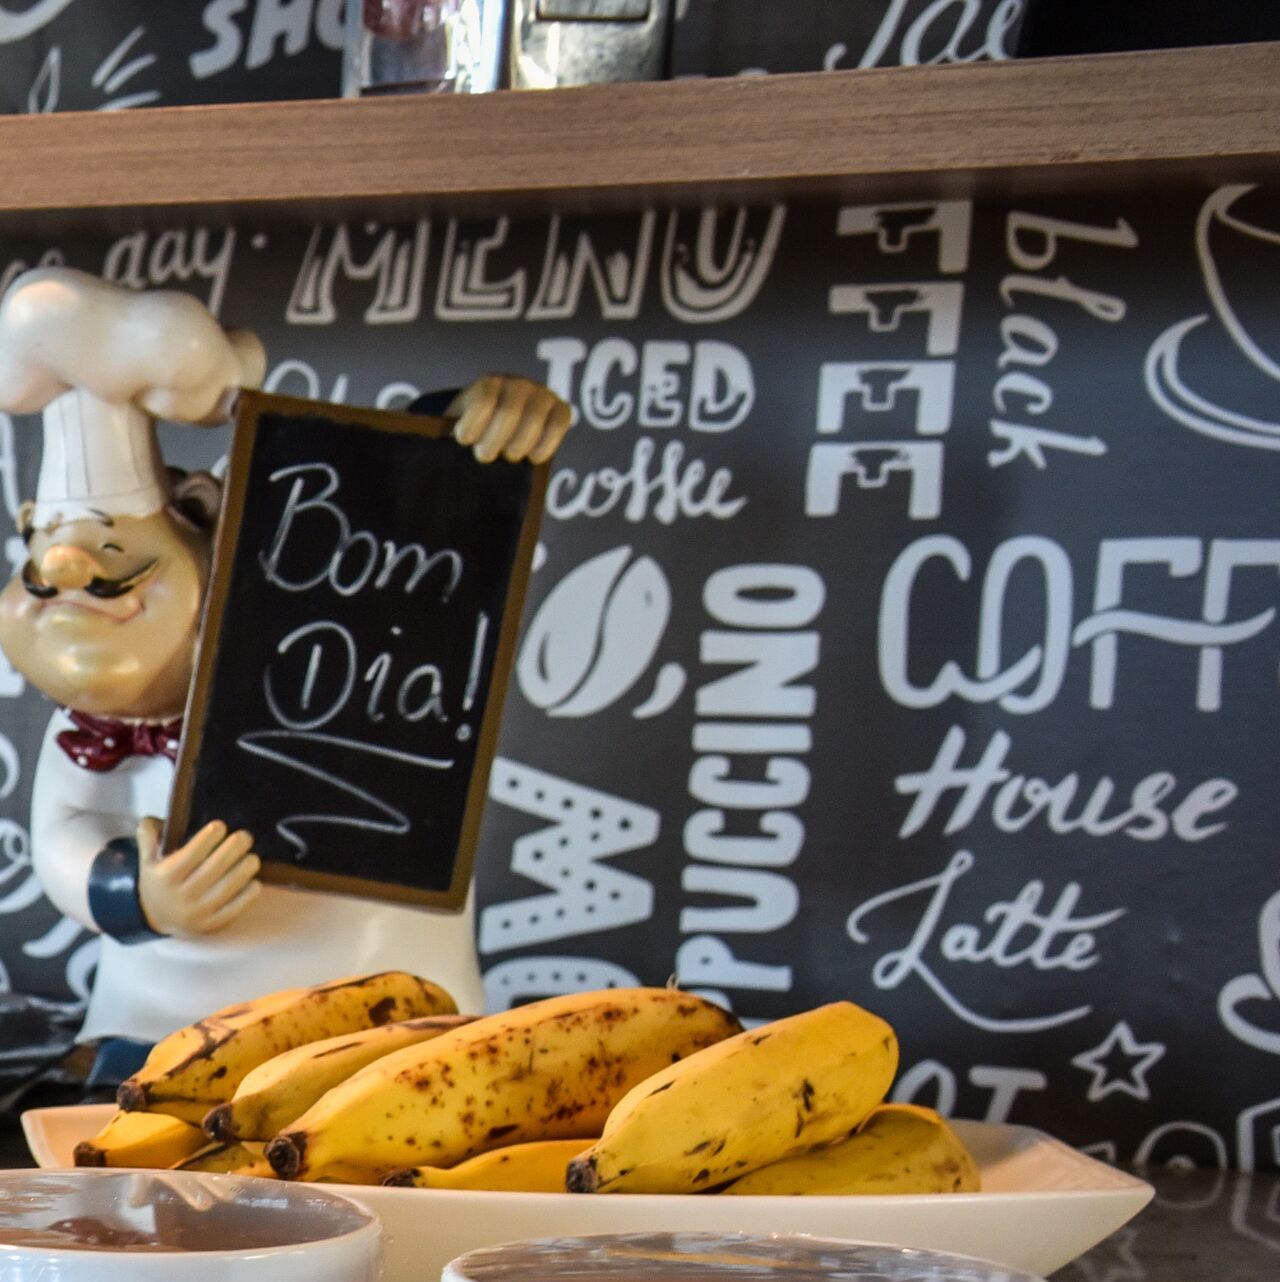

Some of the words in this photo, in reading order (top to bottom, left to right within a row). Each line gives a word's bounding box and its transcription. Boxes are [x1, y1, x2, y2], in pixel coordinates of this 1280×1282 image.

[285, 203, 787, 324] MENU
[534, 335, 757, 433] ICED
[986, 210, 1139, 471] black
[258, 462, 464, 604] Bom
[543, 436, 748, 524] coffee
[262, 611, 490, 742] Dia!
[894, 724, 1239, 842] House
[845, 848, 1131, 1035] Latte
